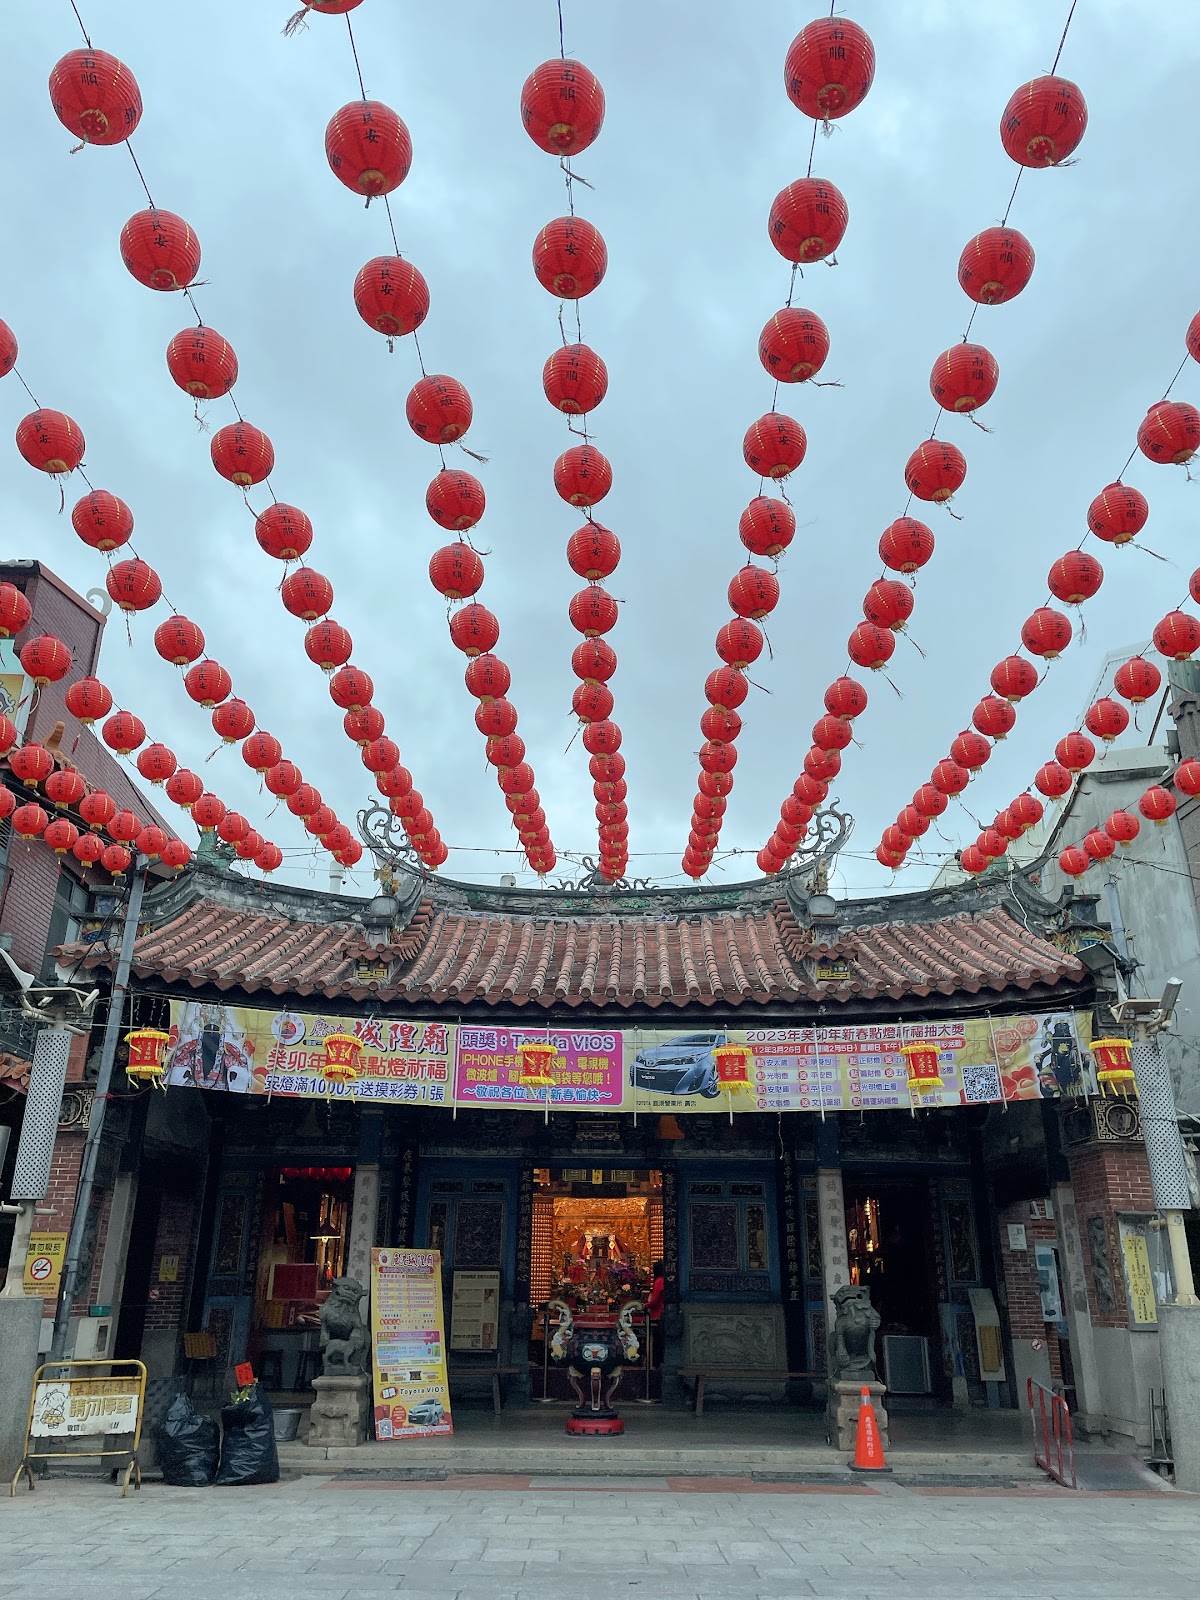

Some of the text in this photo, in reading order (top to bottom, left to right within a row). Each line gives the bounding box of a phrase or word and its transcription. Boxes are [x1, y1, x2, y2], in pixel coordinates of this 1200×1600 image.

[571, 1035, 616, 1050] VIOS
[266, 1050, 448, 1080] 癸卯年春點燈祈福
[69, 1396, 133, 1421] 請勿停車
